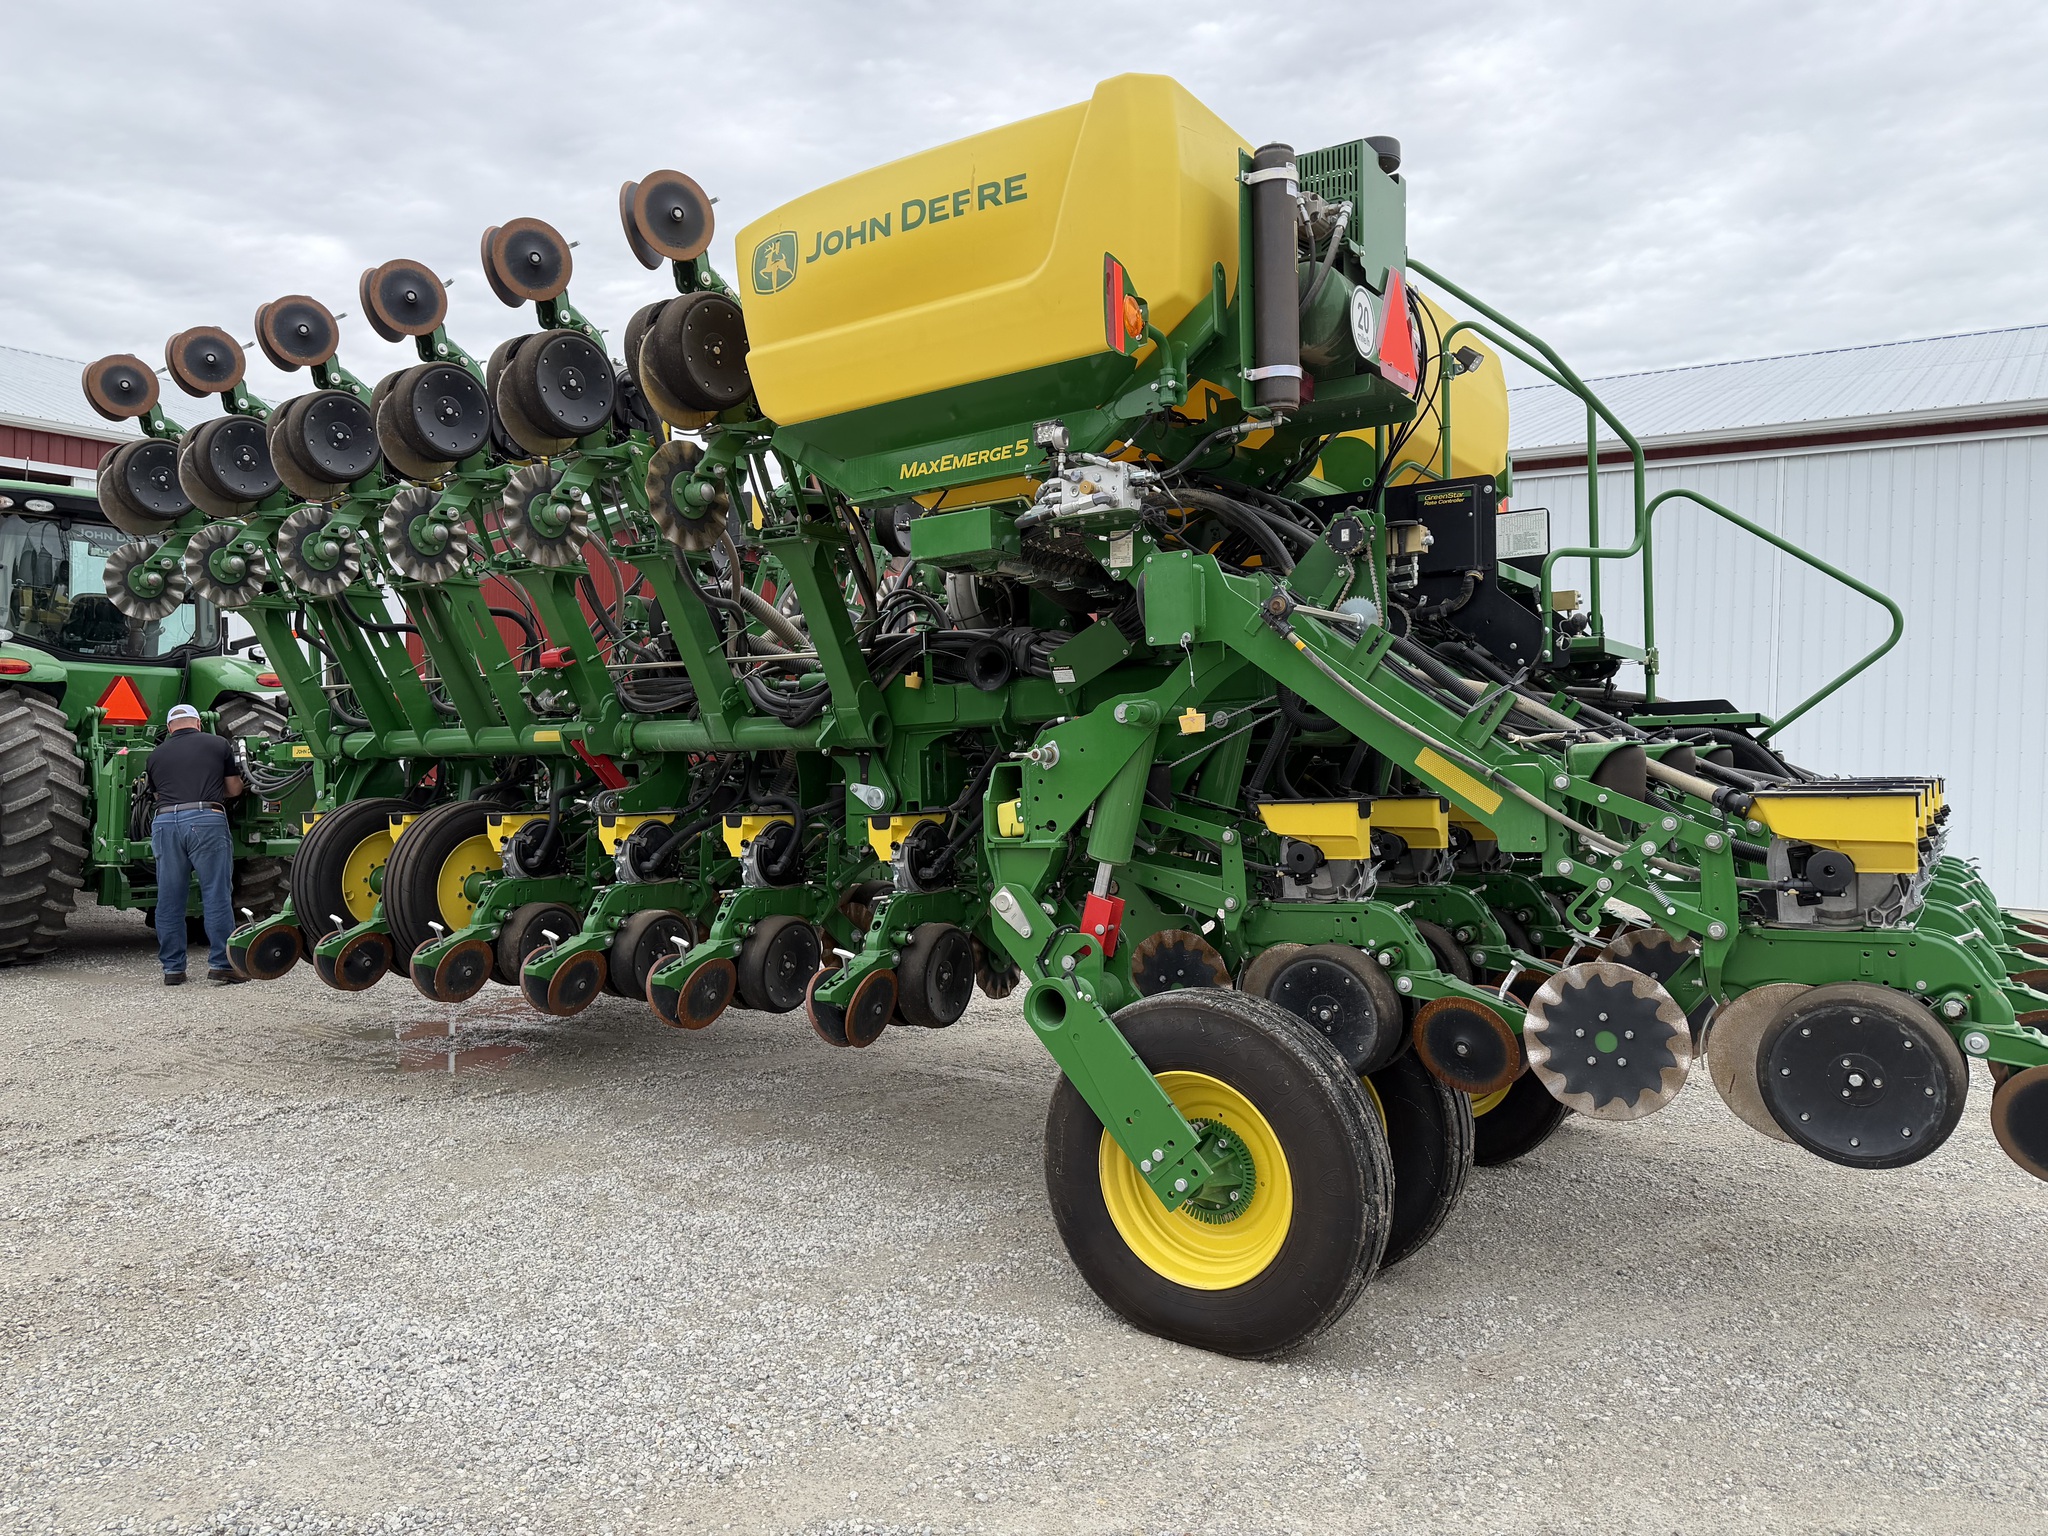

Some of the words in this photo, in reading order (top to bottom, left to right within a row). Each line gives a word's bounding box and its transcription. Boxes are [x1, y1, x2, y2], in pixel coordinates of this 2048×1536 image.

[806, 212, 891, 264] JOHN
[901, 173, 1028, 232] DEERE
[1358, 302, 1370, 334] 20
[1014, 439, 1029, 457] 5
[1424, 492, 1464, 501] GreenStar
[77, 528, 113, 541] JOHN
